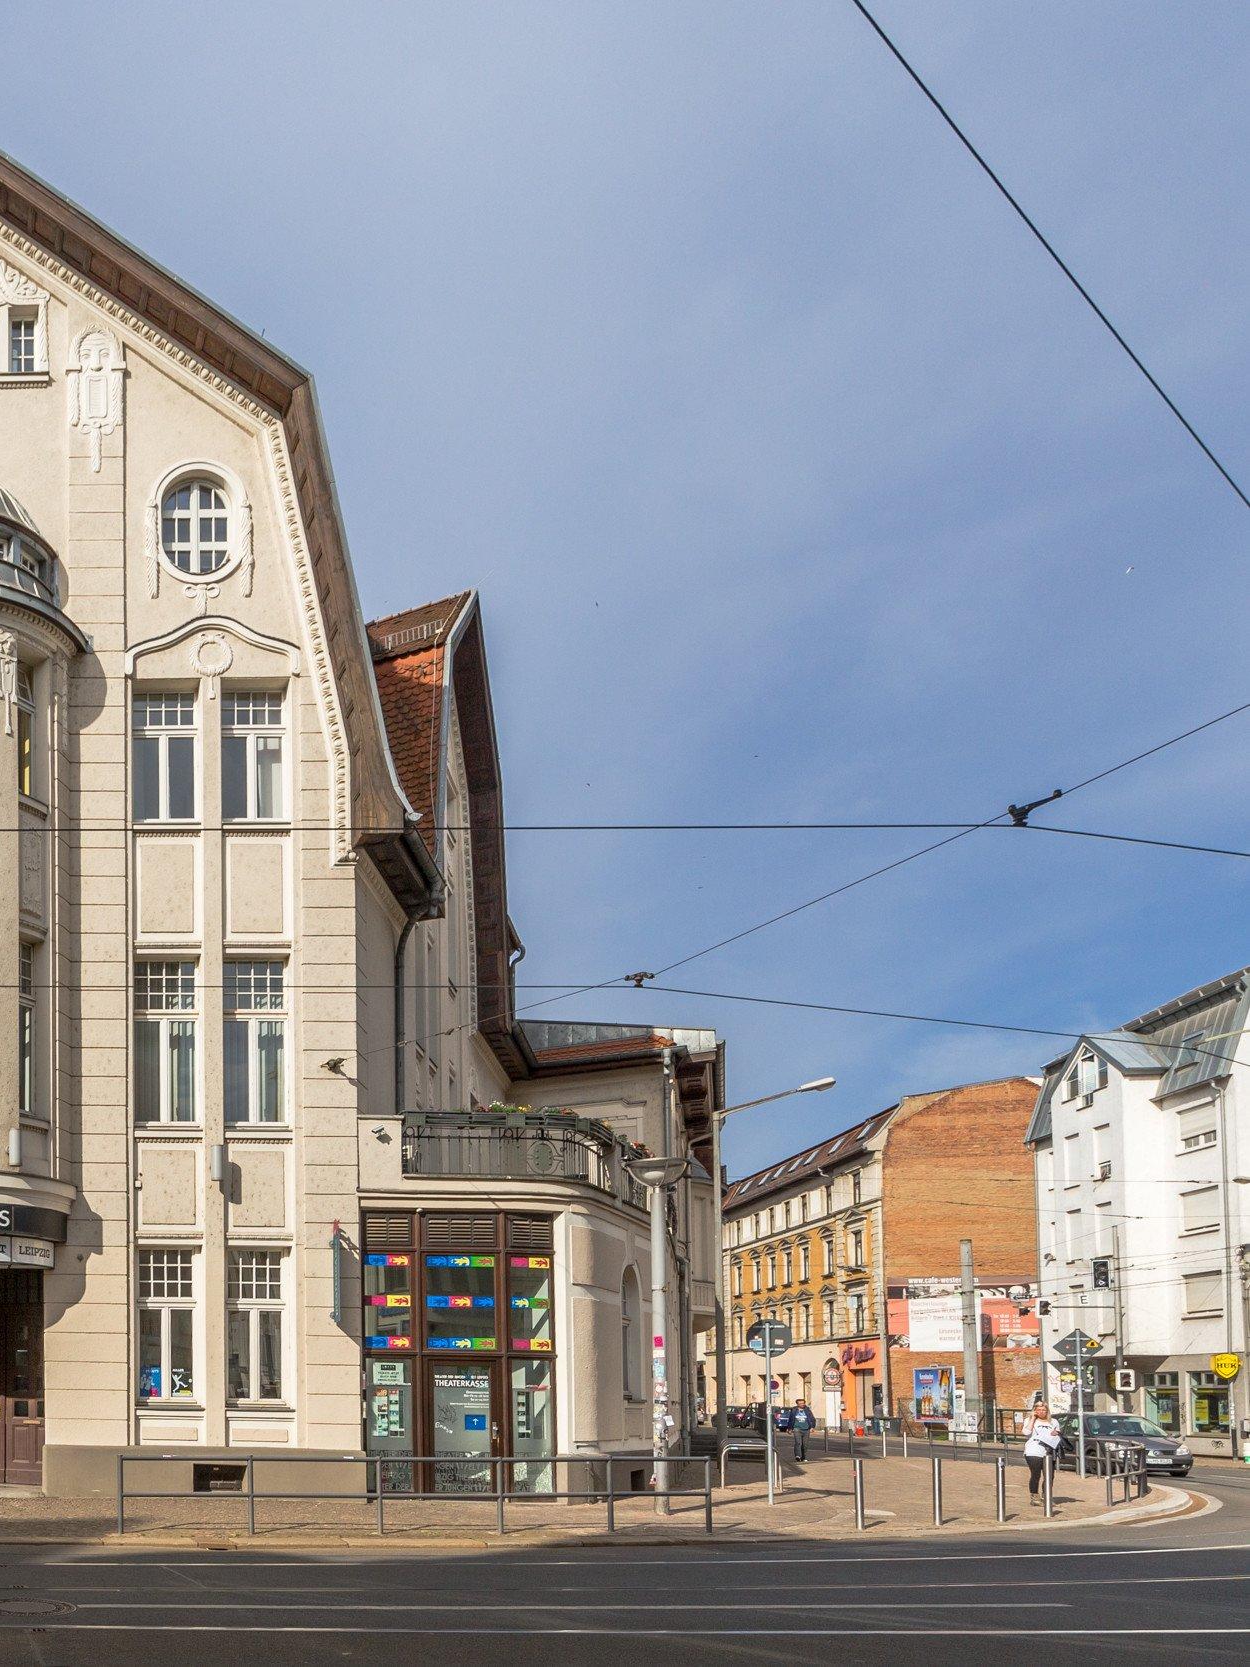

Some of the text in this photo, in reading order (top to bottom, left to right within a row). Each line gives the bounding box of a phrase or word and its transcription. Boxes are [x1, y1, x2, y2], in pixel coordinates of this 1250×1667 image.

[18, 1245, 51, 1259] LEIPZIG
[1080, 1295, 1089, 1305] E
[434, 1379, 489, 1388] THEATERKASSE
